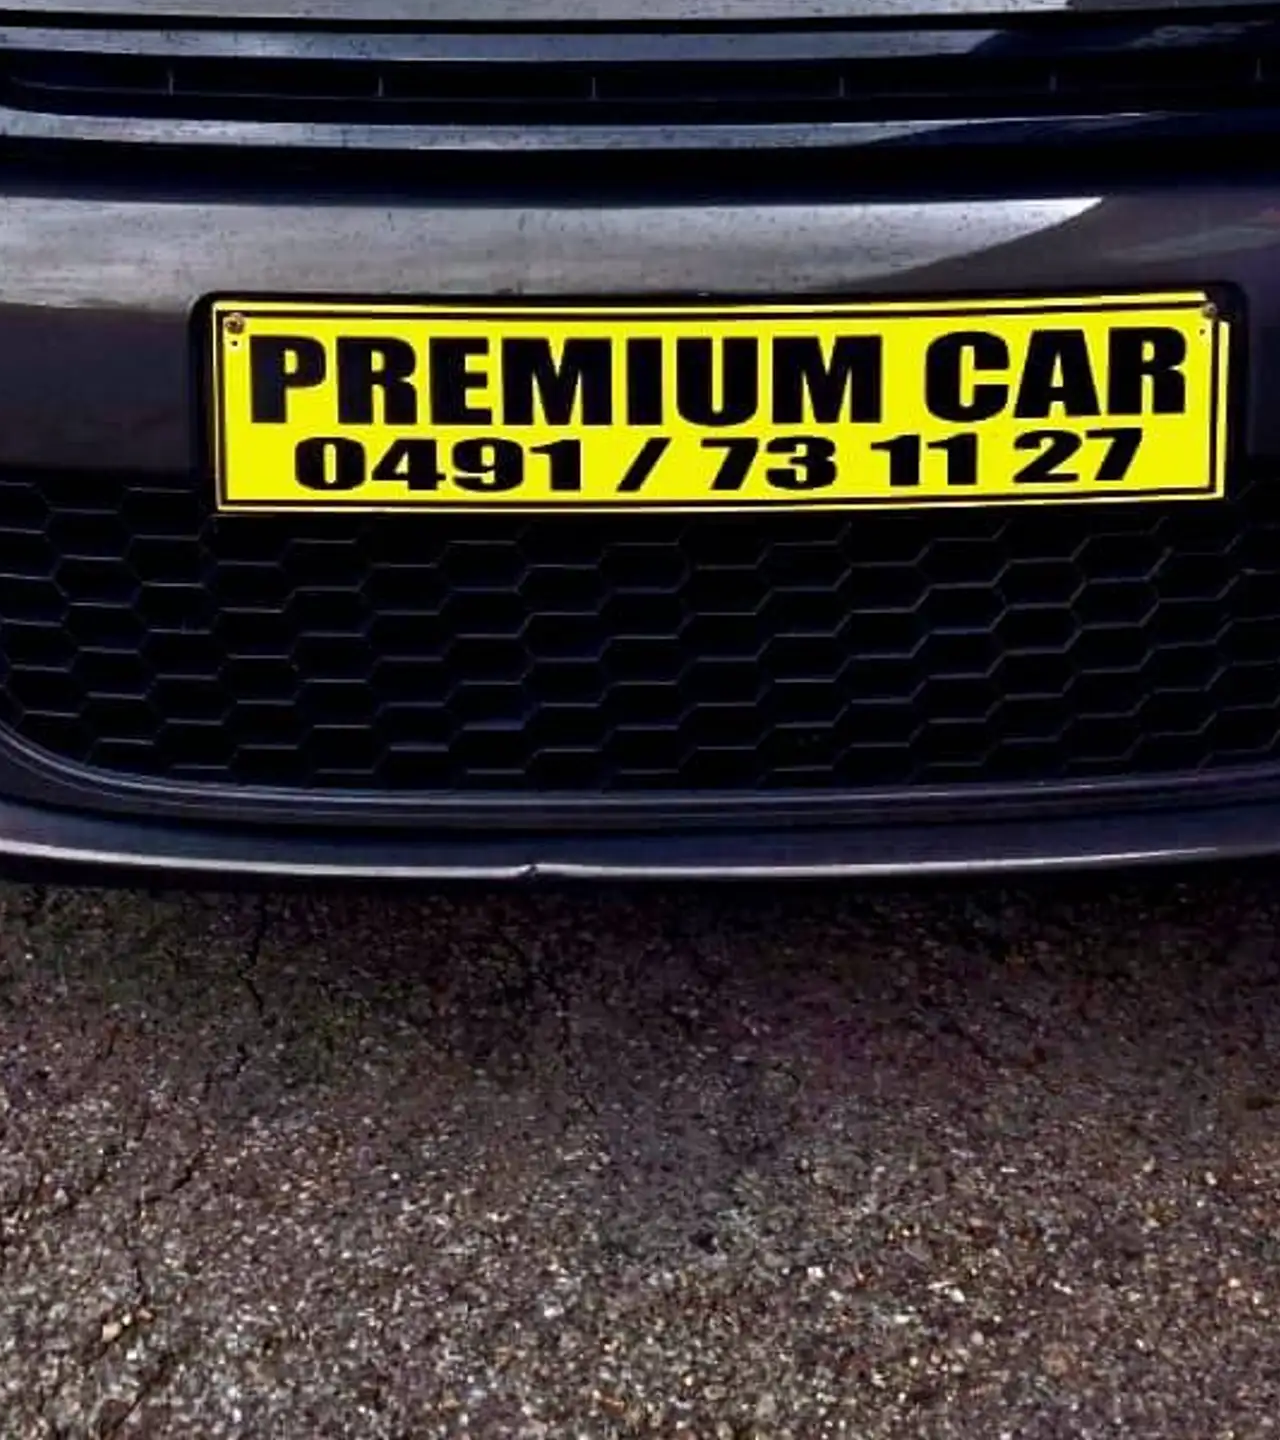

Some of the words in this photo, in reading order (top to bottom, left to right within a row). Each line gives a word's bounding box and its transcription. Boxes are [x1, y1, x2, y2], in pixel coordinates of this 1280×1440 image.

[249, 334, 883, 427] PREMIUM
[925, 326, 1186, 423] CAR
[294, 436, 581, 493] 0491
[700, 435, 837, 491] 73
[1013, 427, 1143, 484] 27
